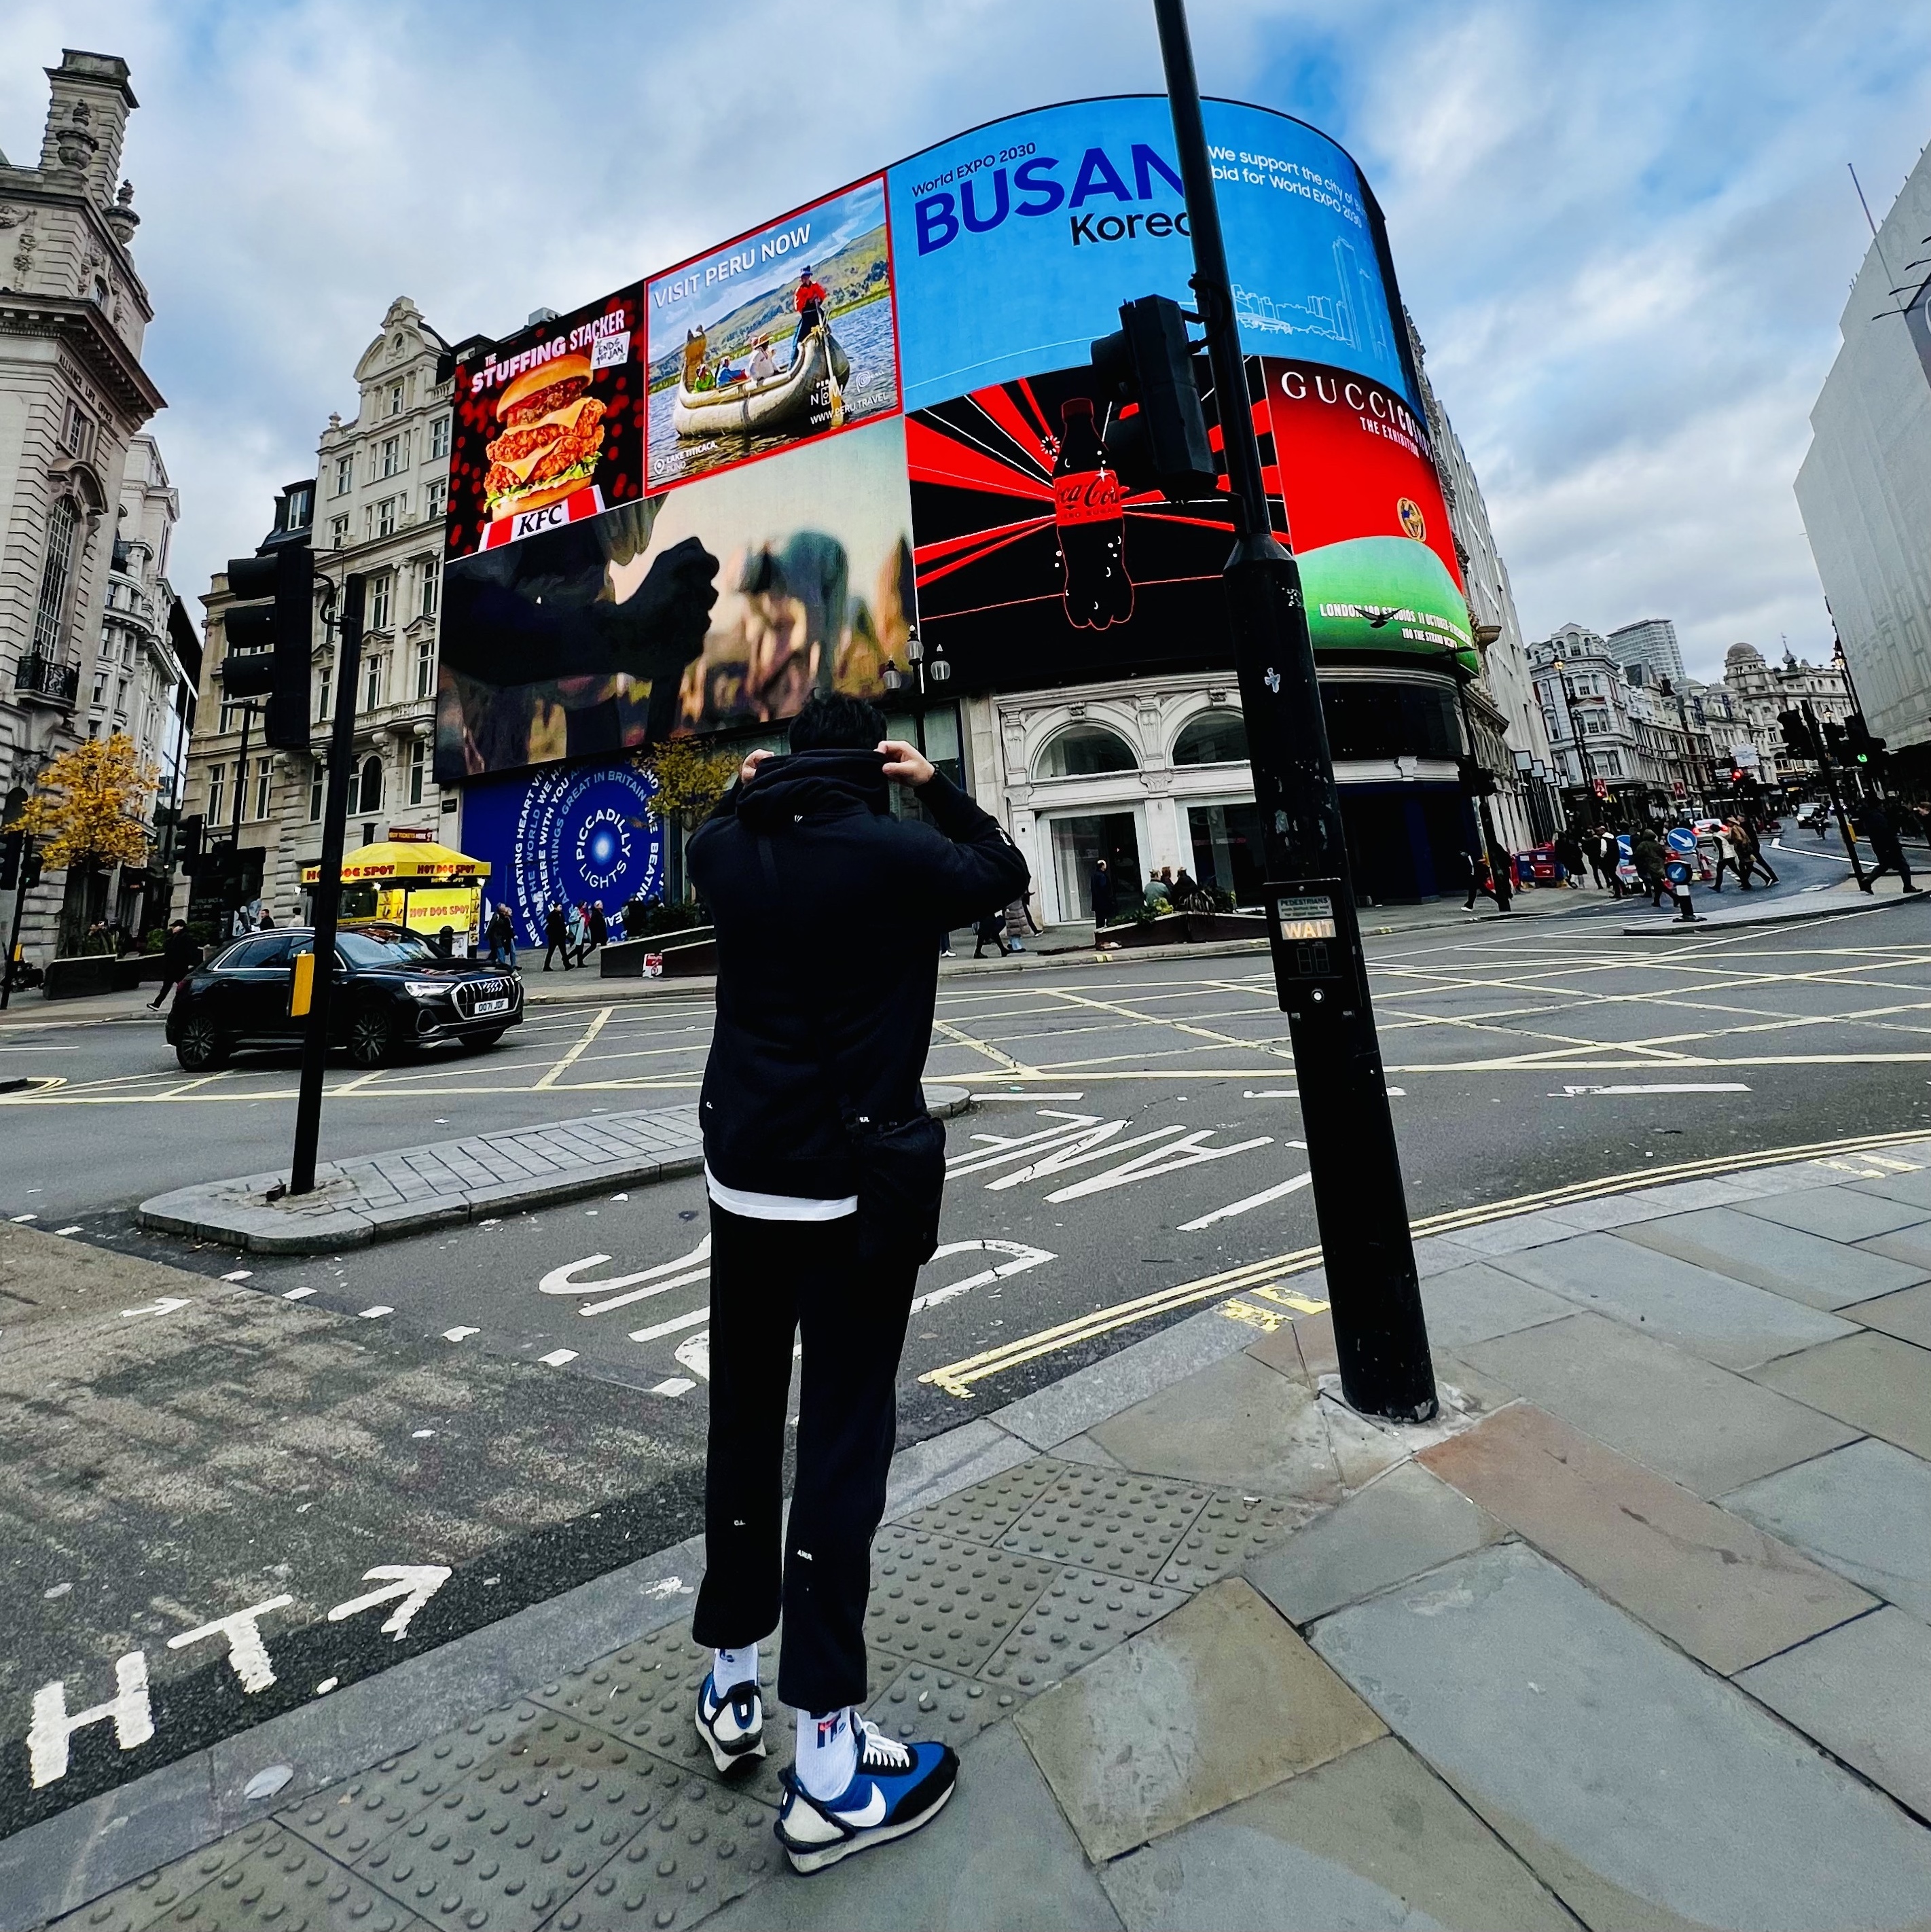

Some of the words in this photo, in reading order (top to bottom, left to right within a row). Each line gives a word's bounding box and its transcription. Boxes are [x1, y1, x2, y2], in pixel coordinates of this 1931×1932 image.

[911, 168, 954, 198] World
[957, 156, 996, 179] EXPO
[998, 141, 1036, 164] 2030
[1208, 145, 1236, 162] We
[1240, 151, 1299, 176] support
[1301, 166, 1322, 186] the
[1324, 179, 1343, 201] city
[913, 143, 1185, 257] BUSAN
[1211, 164, 1239, 181] bid
[1242, 168, 1266, 185] for
[1269, 174, 1312, 199] World
[1312, 188, 1341, 213] EXPO
[653, 276, 701, 308] VISIT
[705, 248, 756, 287] PERU
[761, 223, 811, 262] NOW
[471, 336, 567, 393] STUFFING
[569, 309, 626, 351] STACKER
[484, 353, 497, 366] THE
[598, 338, 620, 355] ENDS
[608, 344, 624, 360] JAN
[1281, 371, 1396, 424] GUCCI
[1359, 416, 1380, 435] THE
[666, 452, 684, 464] LAKE
[517, 505, 562, 536] KFC
[551, 777, 569, 803] YOU
[594, 771, 604, 783] IN
[608, 770, 647, 802] BRITAIN
[537, 781, 552, 804] WE
[562, 777, 590, 815] GREAT
[516, 789, 535, 839] HEART
[539, 806, 555, 845] WITH
[576, 808, 632, 861] PICCADILLY
[363, 865, 395, 876] SPOT
[416, 864, 435, 874] HOT
[436, 864, 454, 874] DOG
[455, 864, 476, 874] SPOT
[514, 842, 527, 907] BEATING
[539, 849, 552, 901] THERE
[579, 860, 627, 889] LIGHTS
[635, 842, 659, 901] BEATIN
[556, 877, 570, 904] ALL
[1280, 897, 1329, 907] PEDESTRIANS
[410, 908, 428, 918] HOT
[430, 906, 448, 916] DOG
[450, 905, 469, 915] SPOT
[522, 907, 530, 918] A
[526, 920, 543, 947] ARE
[1284, 919, 1334, 939] WAIT
